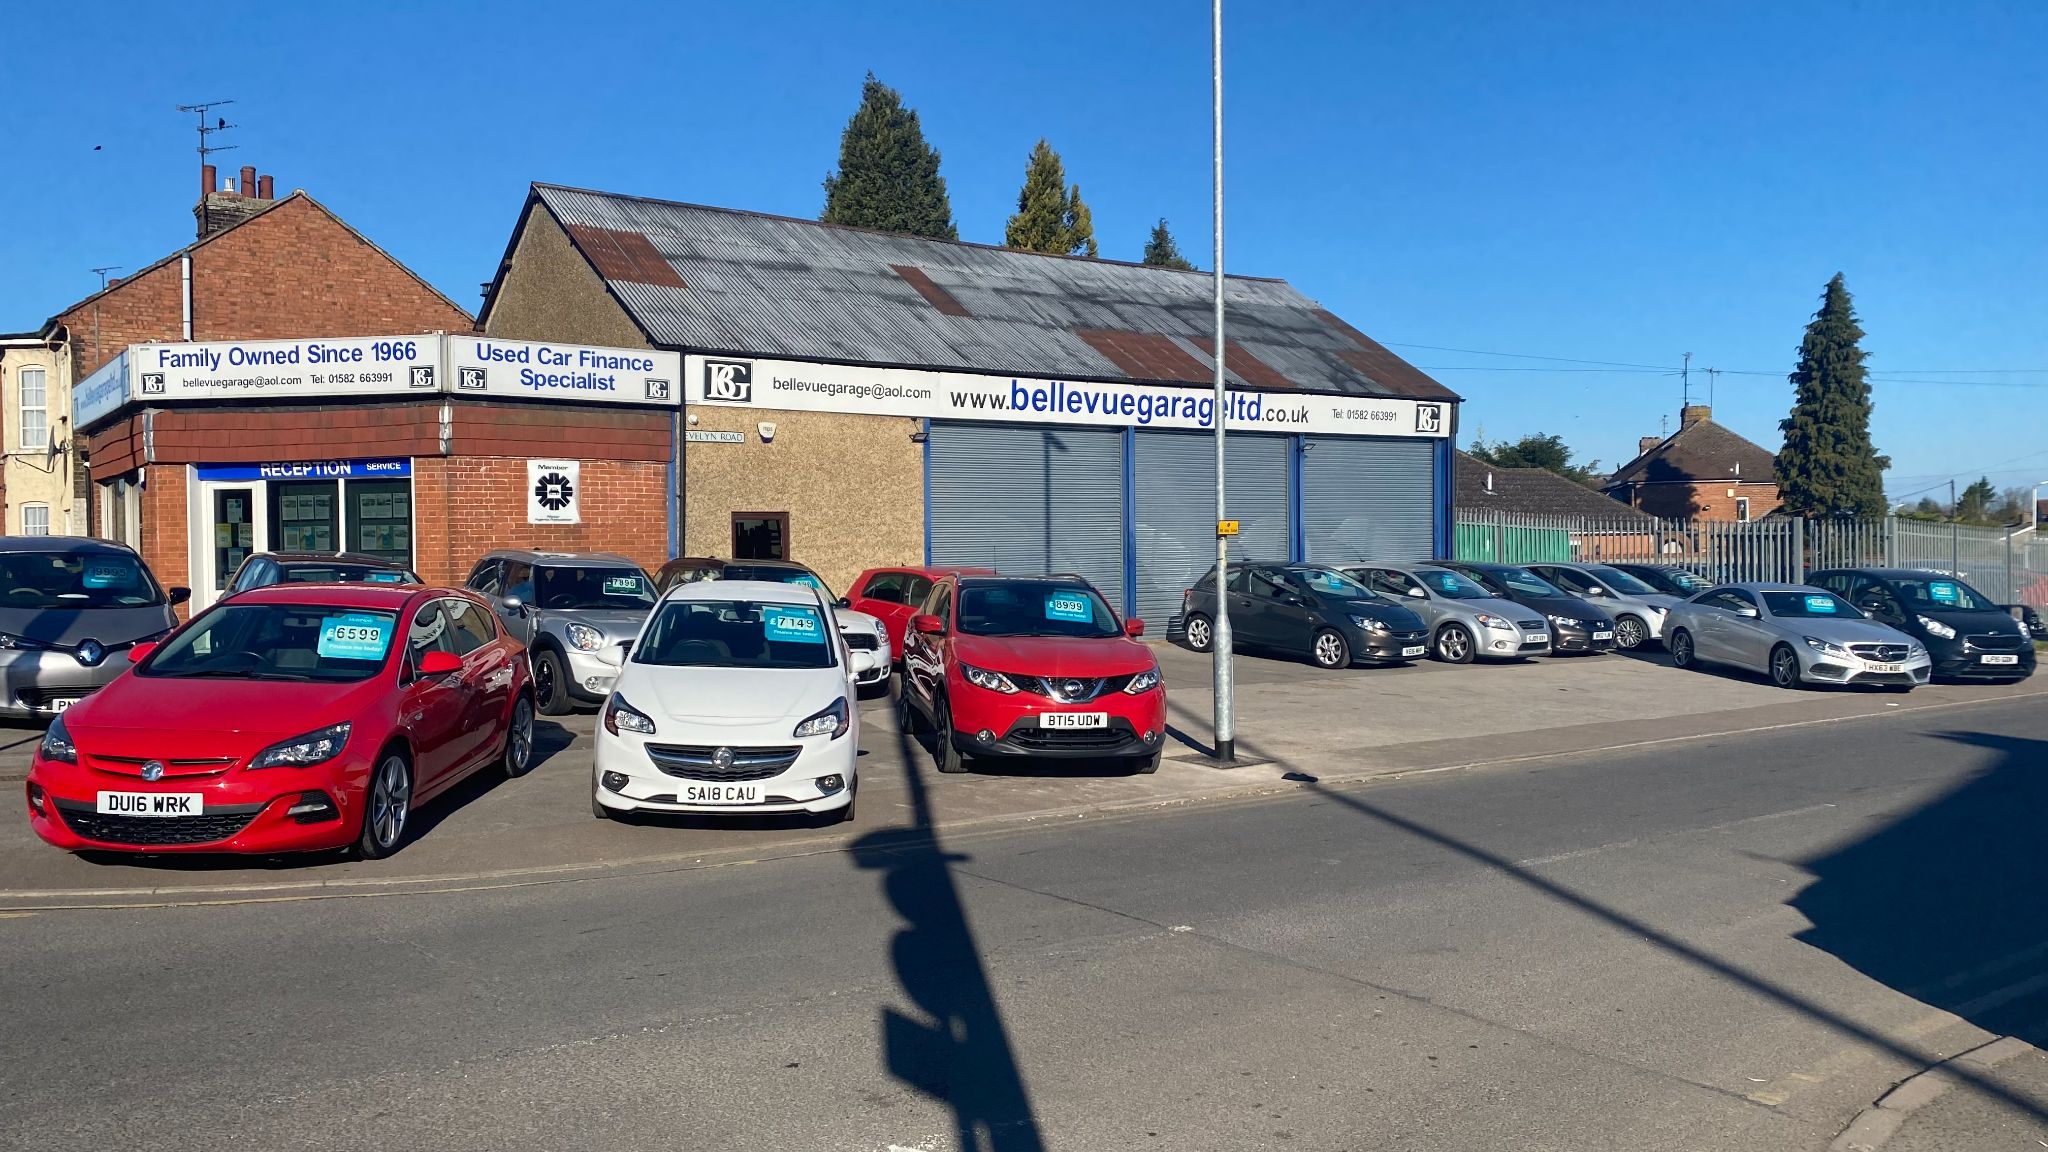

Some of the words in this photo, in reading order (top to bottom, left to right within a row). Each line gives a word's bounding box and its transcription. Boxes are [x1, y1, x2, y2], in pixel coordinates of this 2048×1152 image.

[159, 348, 221, 371] Family
[228, 345, 300, 366] Owned
[307, 344, 363, 364] Since
[371, 341, 417, 361] 1966
[476, 343, 530, 363] Used
[537, 347, 572, 366] Car
[579, 350, 654, 372] Finance
[183, 375, 302, 389] bellevuegarage@aol.com
[310, 375, 325, 383] Tel:
[328, 374, 355, 383] 01582
[359, 373, 393, 382] 663991
[520, 368, 616, 391] Specialist
[773, 377, 931, 399] bellevuegarage@aol.com
[1347, 409, 1368, 420] 01582
[1370, 411, 1397, 421] 663991
[720, 433, 743, 441] ROAD
[260, 461, 352, 477] RECEPTION
[366, 462, 401, 471] SERVICE
[1048, 715, 1075, 726] BT15
[1077, 715, 1101, 726] UDW
[687, 787, 721, 801] SA18
[725, 787, 756, 801] CAU
[108, 795, 147, 812] DU16
[153, 796, 191, 813] WRK
